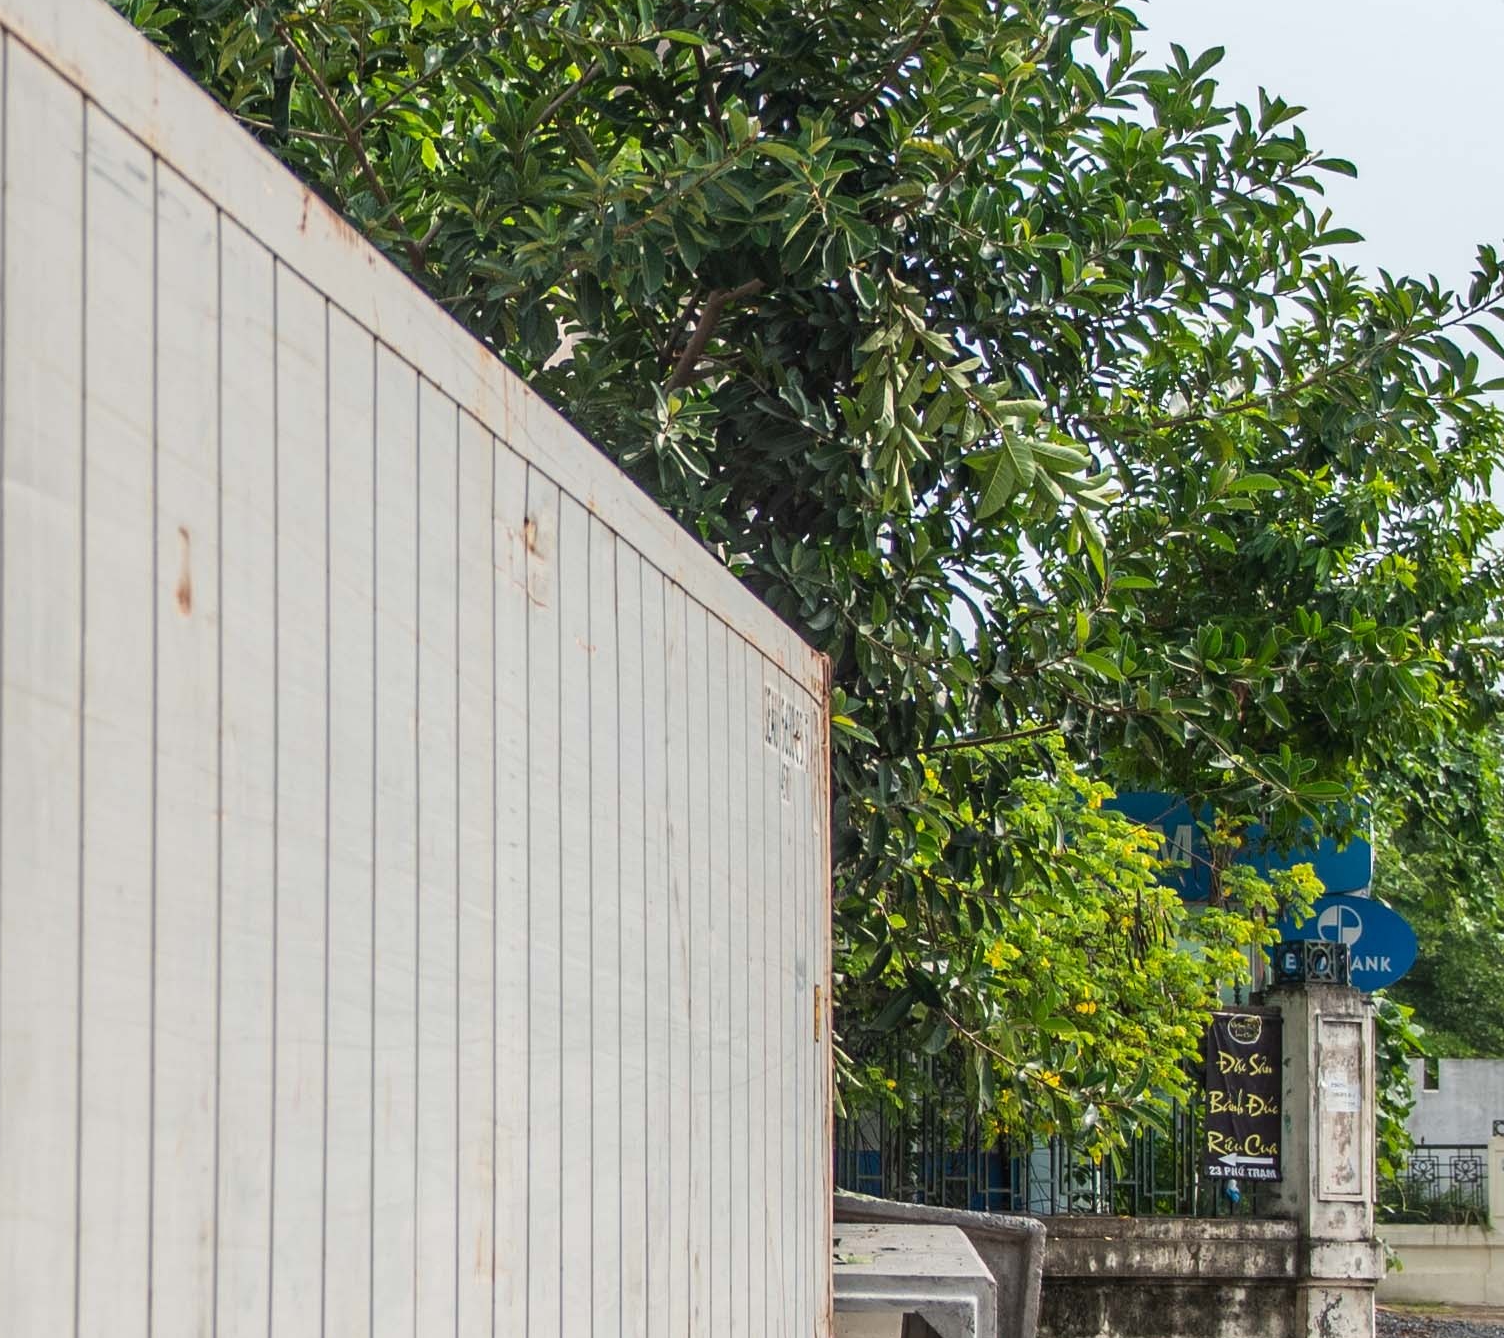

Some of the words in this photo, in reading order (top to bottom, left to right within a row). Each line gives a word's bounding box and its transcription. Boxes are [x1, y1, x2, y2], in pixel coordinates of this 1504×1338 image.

[1209, 1088, 1244, 1116] Bánh
[1245, 1093, 1279, 1117] Đúc
[1207, 1130, 1243, 1156] Riêu
[1244, 1134, 1279, 1156] Cua
[1209, 1165, 1222, 1176] 23
[1224, 1164, 1245, 1177] PHỐ
[1246, 1167, 1277, 1181] TRẠM
